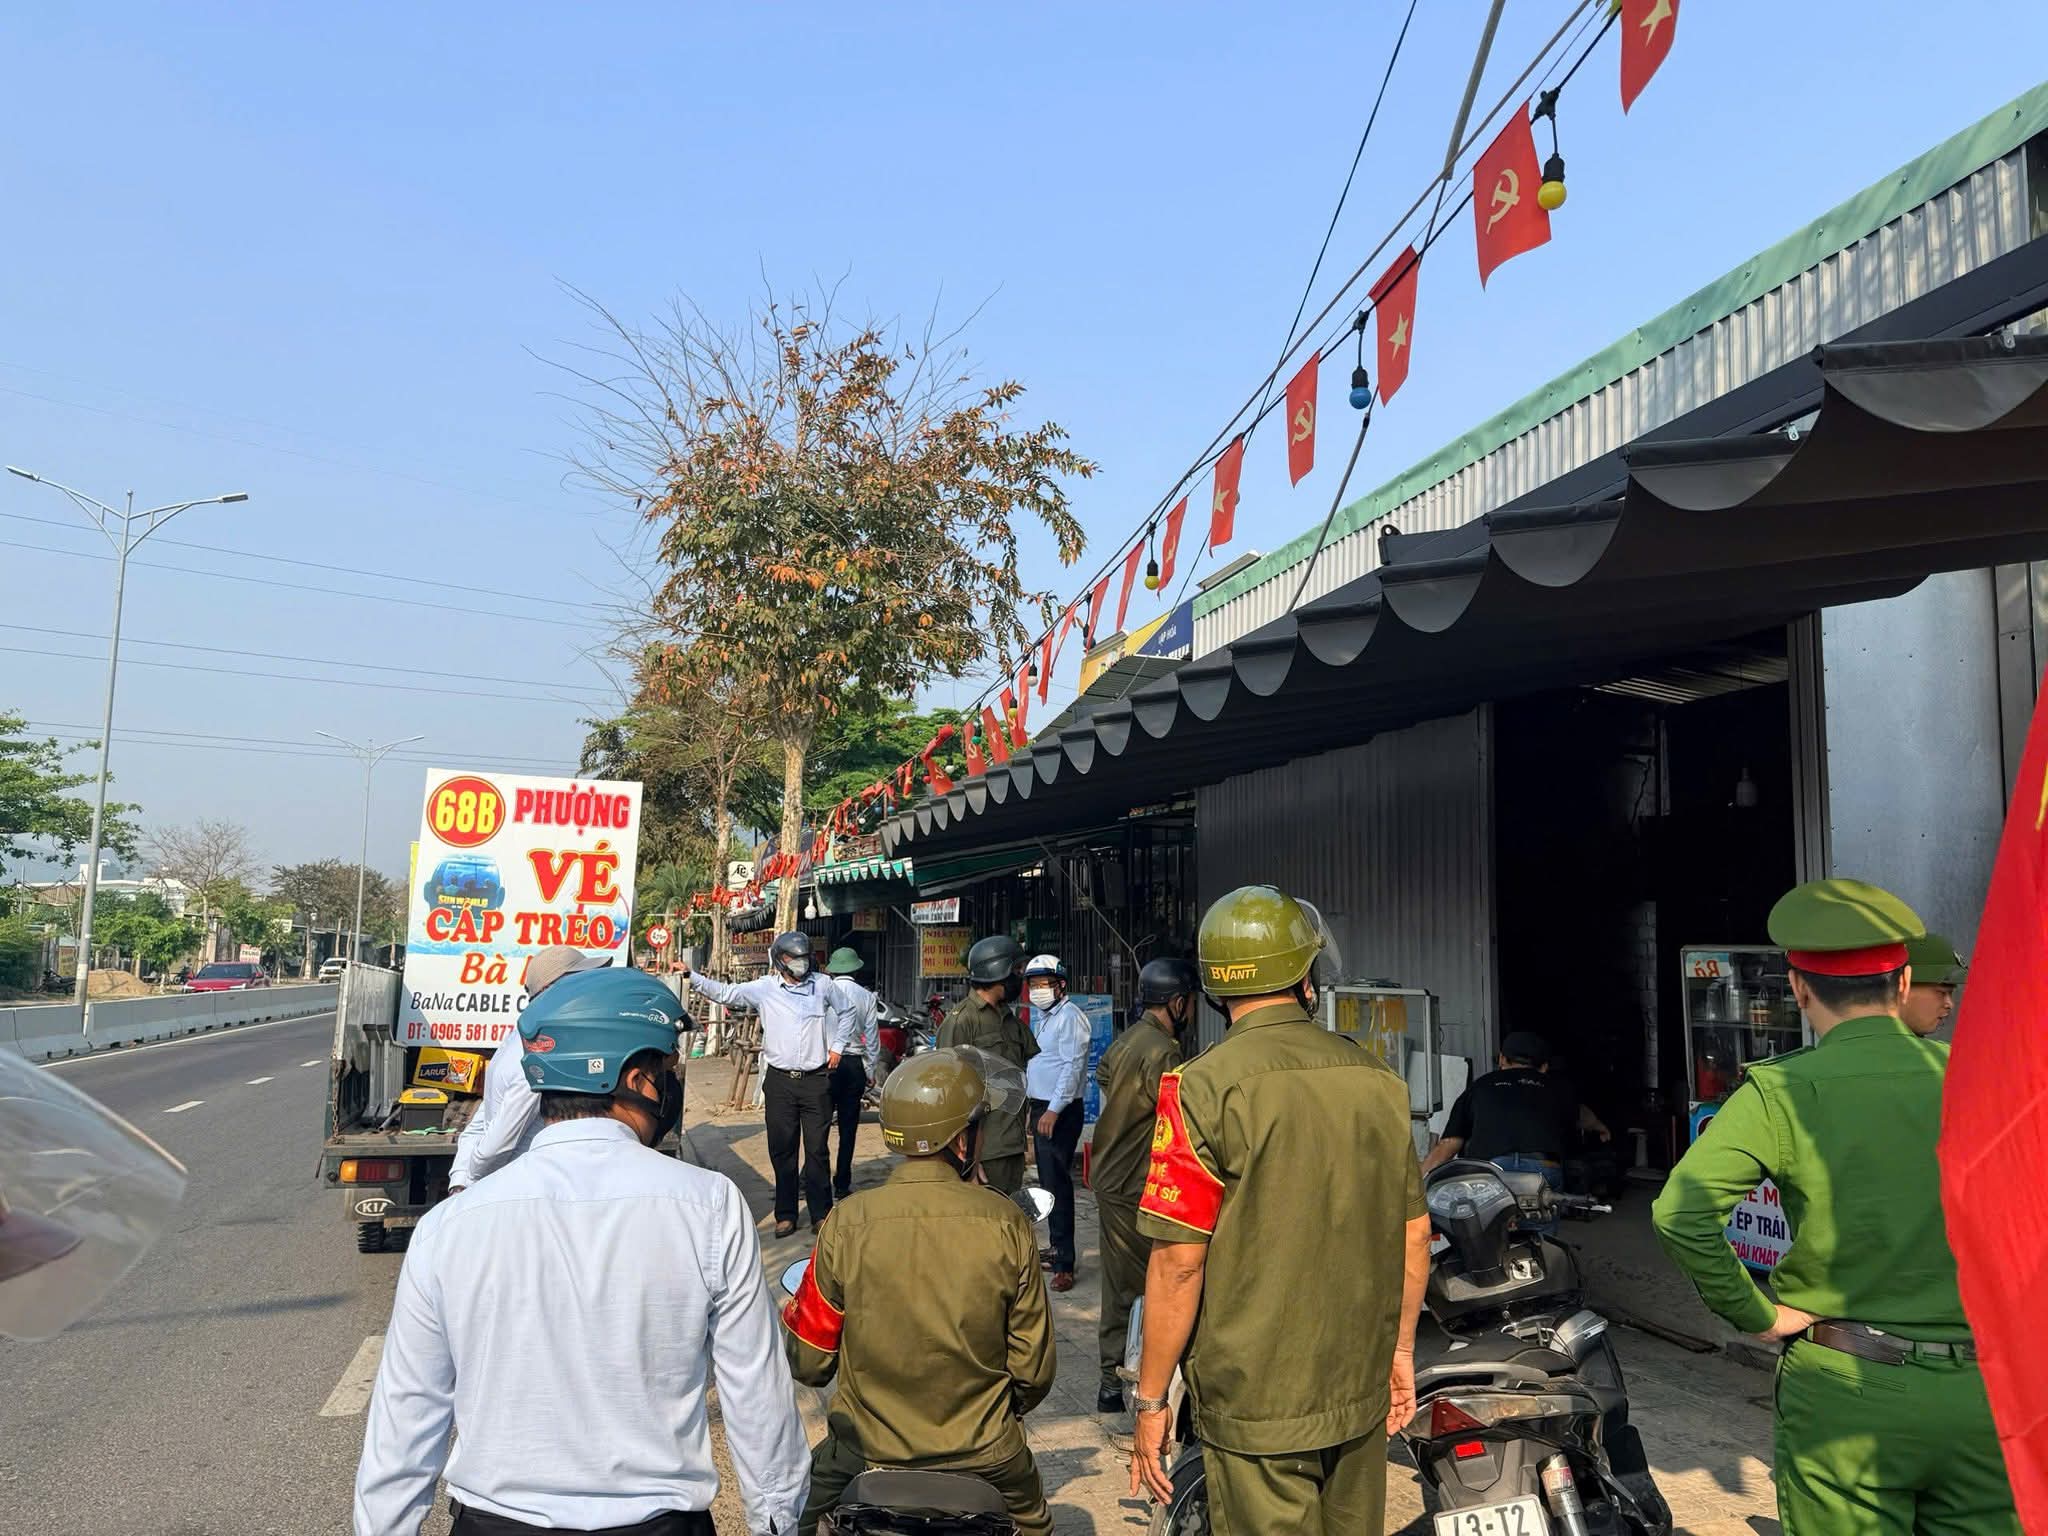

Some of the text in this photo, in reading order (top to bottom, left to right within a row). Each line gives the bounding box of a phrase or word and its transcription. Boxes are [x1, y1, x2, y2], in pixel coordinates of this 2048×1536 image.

[435, 789, 497, 834] 68B
[512, 783, 631, 837] PHƯỢNG
[527, 840, 620, 906] VÉ
[426, 902, 505, 944] CÁP
[460, 952, 508, 985] Bà
[455, 993, 511, 1013] CABLE
[516, 995, 528, 1013] C
[430, 1023, 461, 1041] 0905
[466, 1024, 487, 1041] 581
[420, 1068, 446, 1077] LARUE
[1756, 1215, 1785, 1240] TRÁI
[1751, 1244, 1780, 1267] KHÁT
